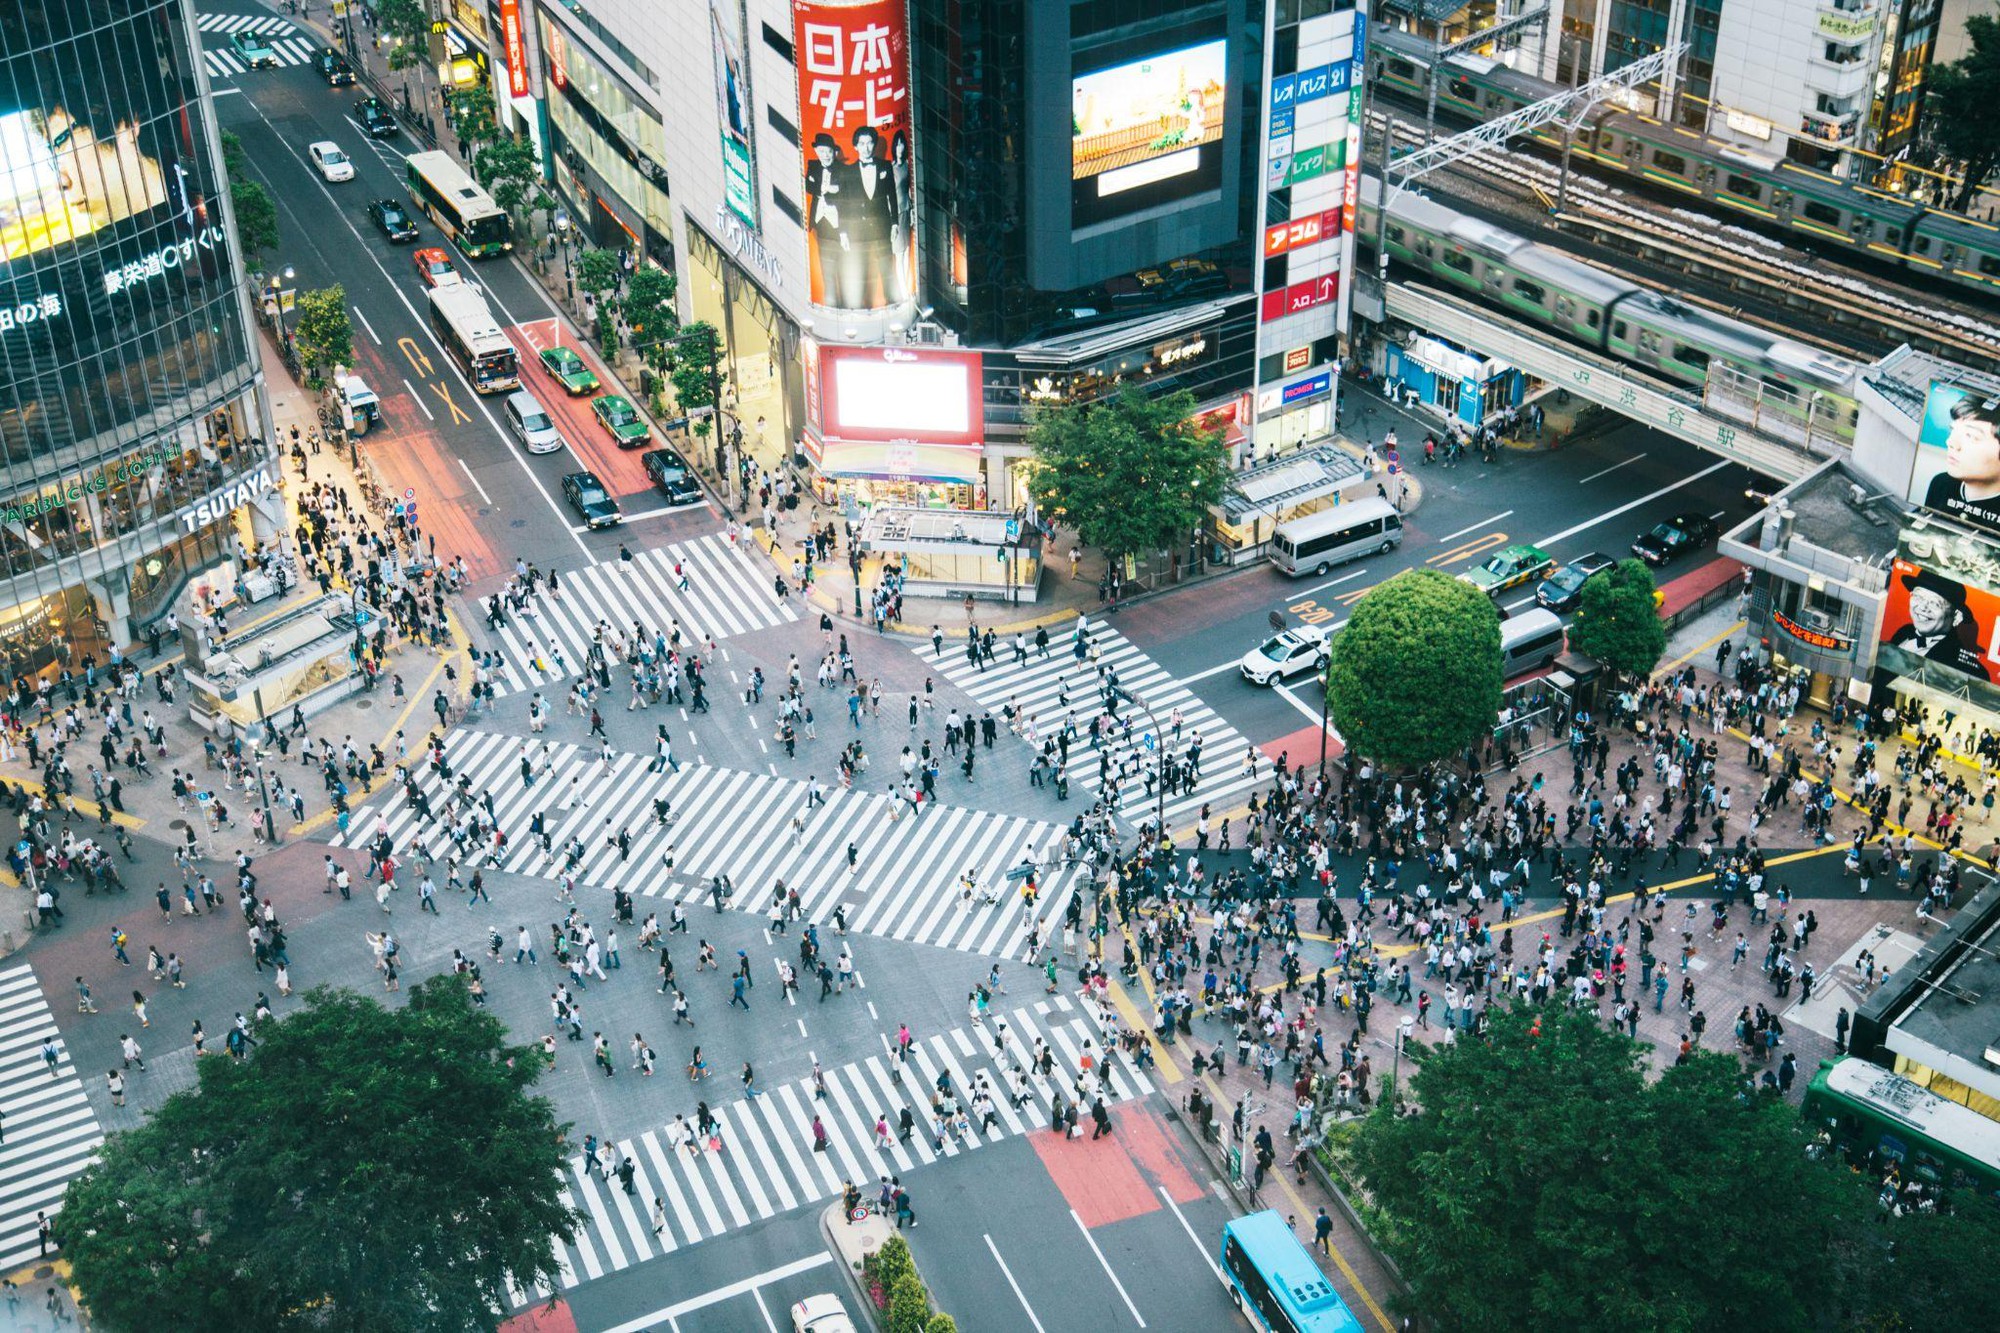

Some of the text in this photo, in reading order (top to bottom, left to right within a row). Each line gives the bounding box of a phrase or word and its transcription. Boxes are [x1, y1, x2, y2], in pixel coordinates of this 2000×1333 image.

[804, 22, 892, 76] 日本
[1274, 66, 1345, 104] レオパレス21
[809, 75, 906, 129] ダービー
[1293, 154, 1323, 175] レイク
[1271, 222, 1319, 249] アコム
[1291, 294, 1311, 310] 入口
[1284, 382, 1314, 399] PROMISE
[1573, 369, 1591, 384] JR
[1619, 385, 1736, 448] 渋谷駅
[0, 475, 107, 524] ARBUCKS
[182, 468, 273, 533] TSUTAYA
[1288, 600, 1336, 625] 8-20
